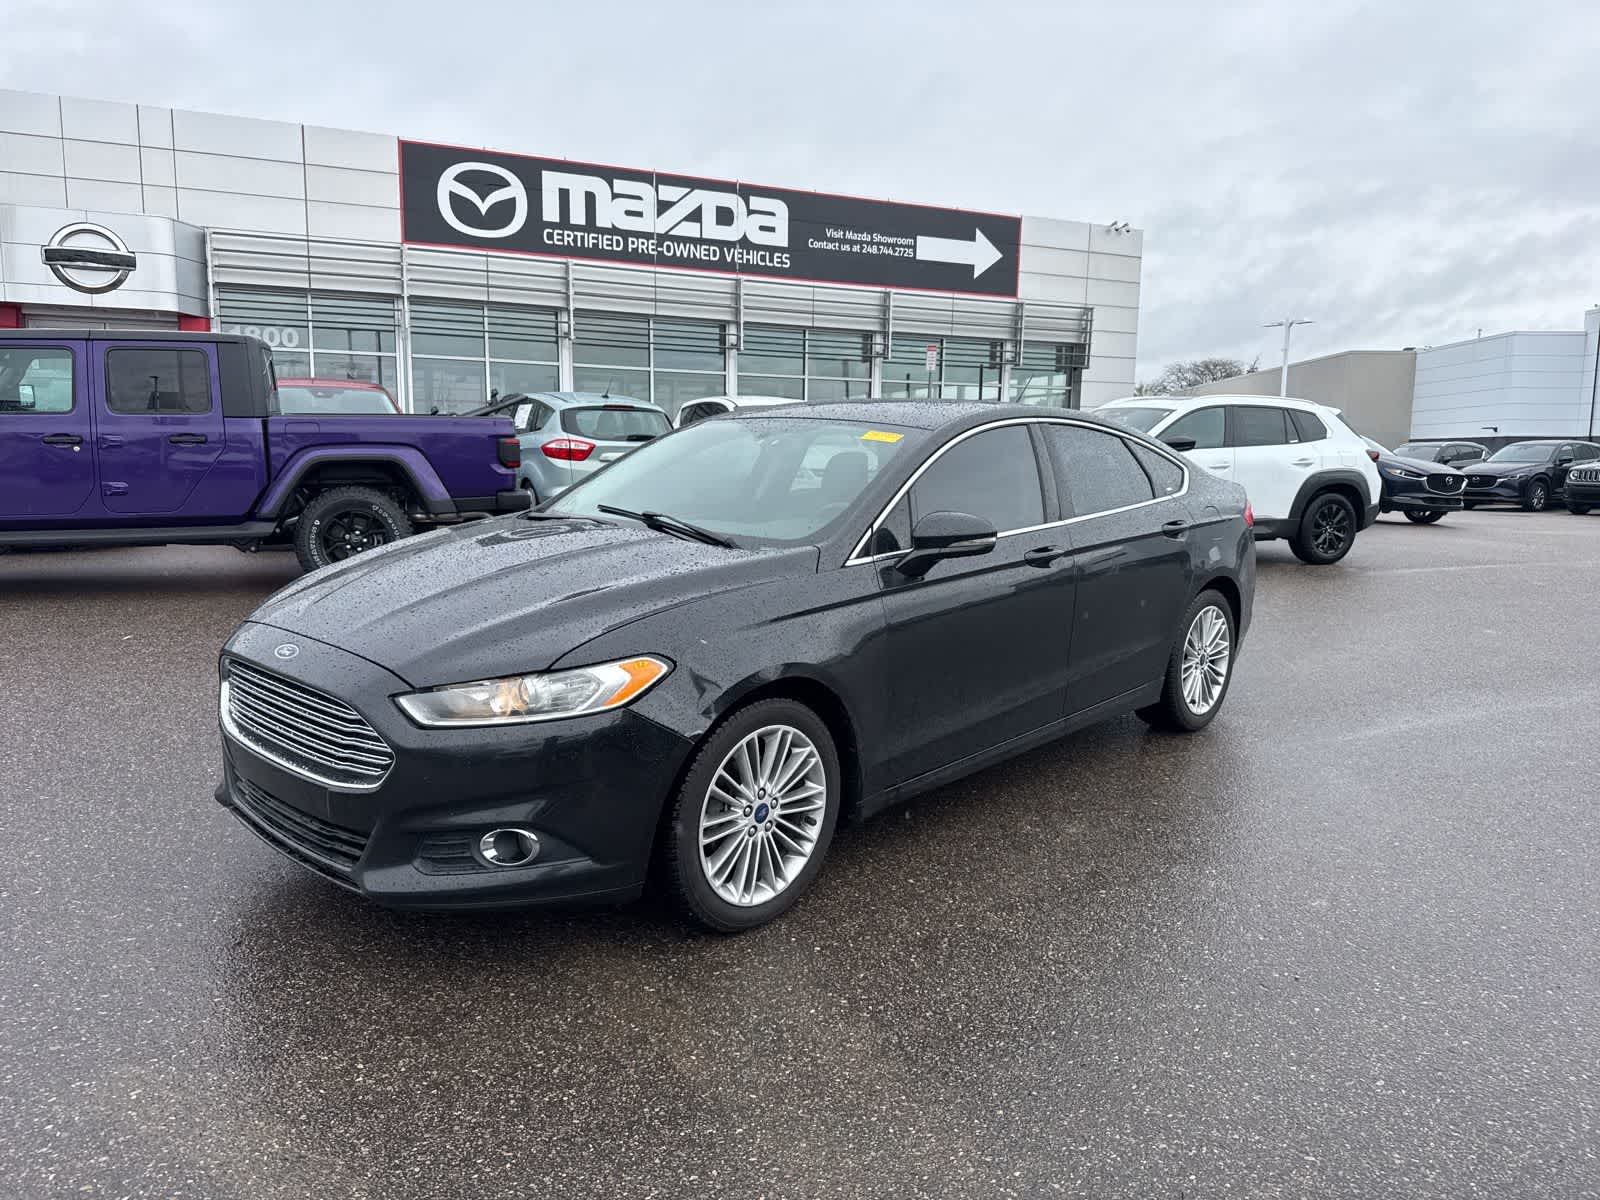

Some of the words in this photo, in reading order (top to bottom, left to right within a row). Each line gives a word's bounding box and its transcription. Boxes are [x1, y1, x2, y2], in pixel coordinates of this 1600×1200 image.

[825, 228, 843, 239] Visit
[845, 230, 871, 242] Mazda
[872, 233, 914, 246] Showroom
[543, 228, 623, 251] CERTIFIED
[628, 237, 720, 261] PRE-OWNED
[724, 247, 790, 268] VEHICLES
[808, 238, 839, 250] Contact
[840, 243, 850, 252] us
[852, 244, 860, 252] at
[862, 244, 914, 257] 248.744.2725
